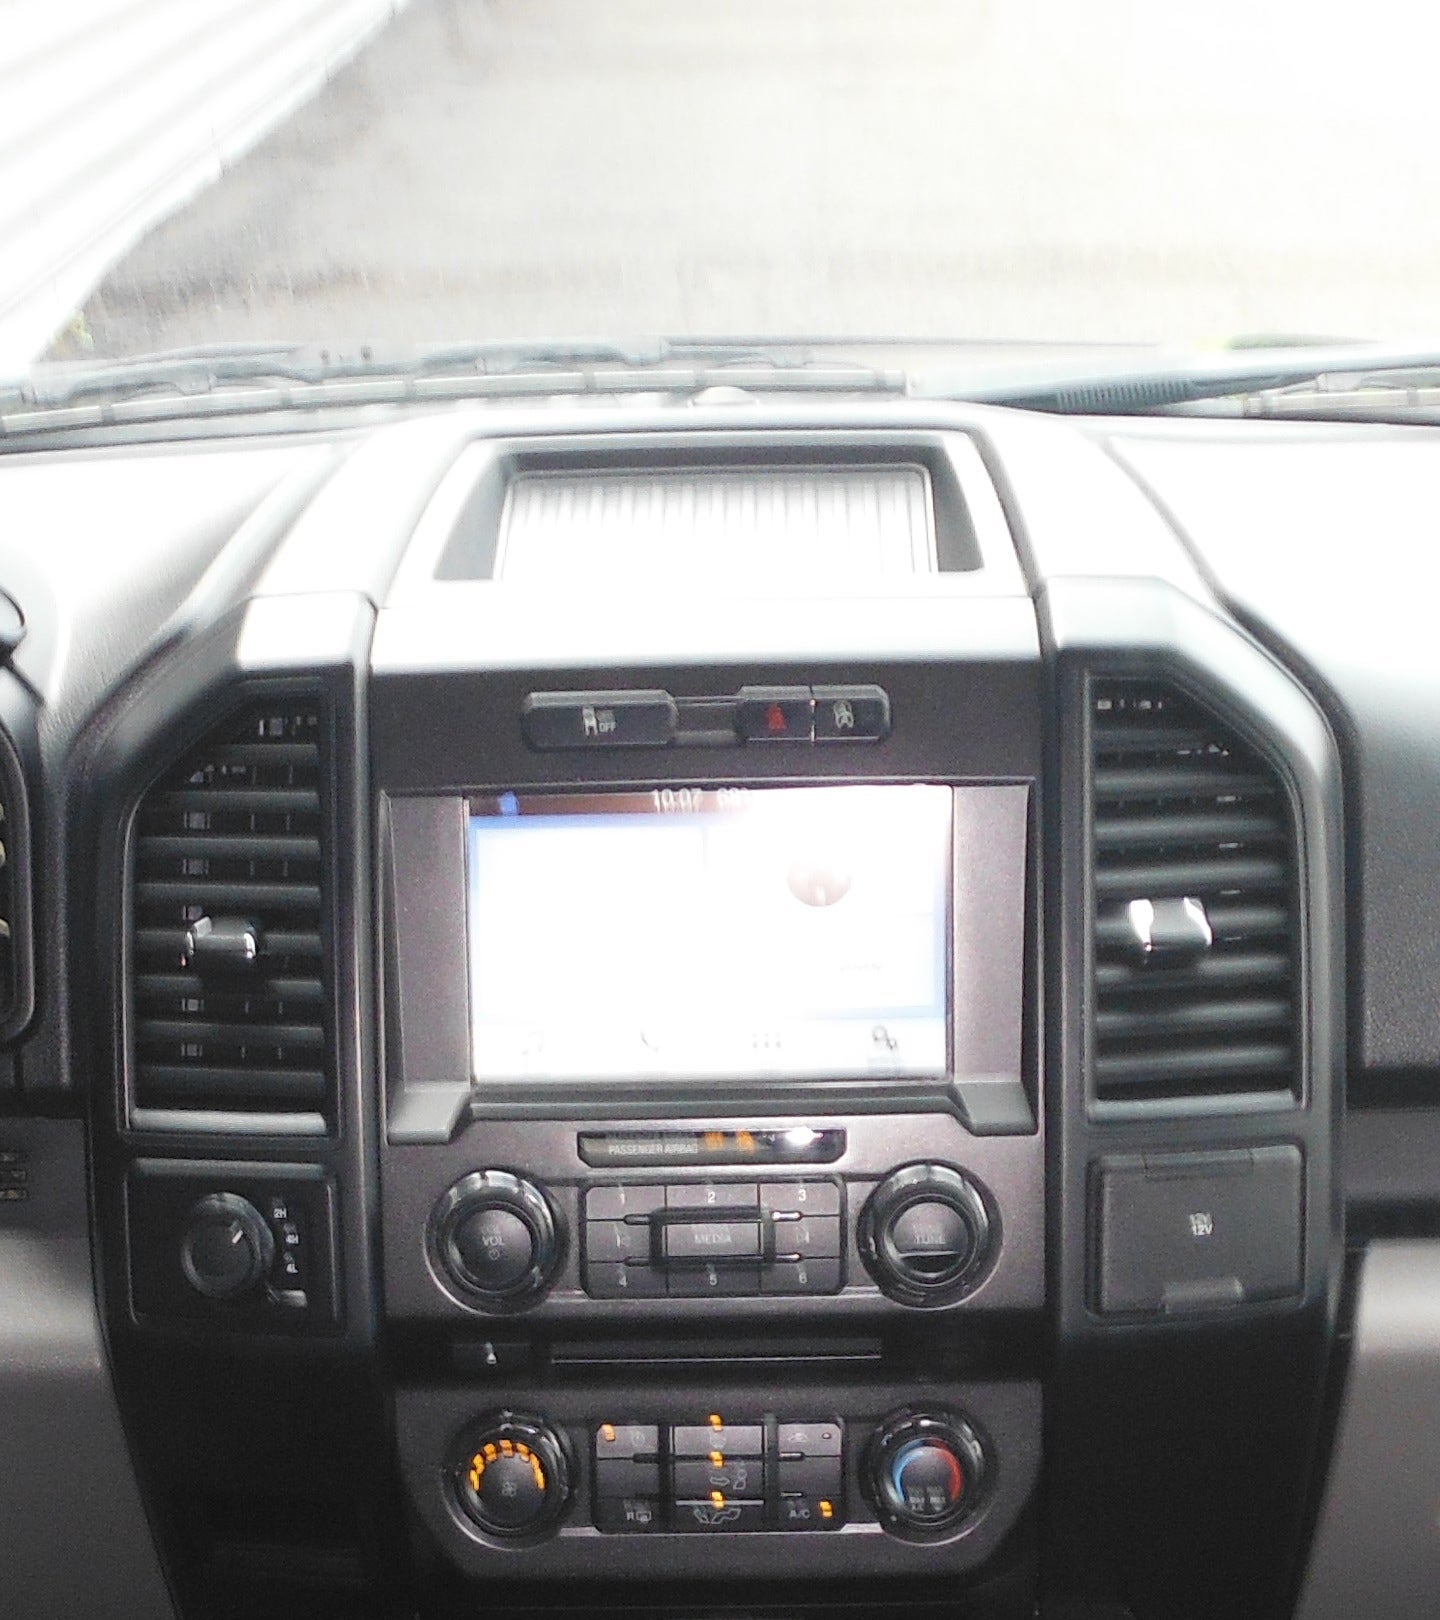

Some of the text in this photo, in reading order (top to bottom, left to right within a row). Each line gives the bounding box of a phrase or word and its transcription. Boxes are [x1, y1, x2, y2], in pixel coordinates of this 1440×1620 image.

[599, 722, 616, 733] OFF
[707, 1191, 716, 1203] 2
[798, 1189, 807, 1201] 3
[1191, 1224, 1213, 1235] 12V
[482, 1235, 505, 1246] VOL
[619, 1276, 627, 1287] 4
[798, 1273, 807, 1284] 6
[789, 1509, 810, 1519] A/C
